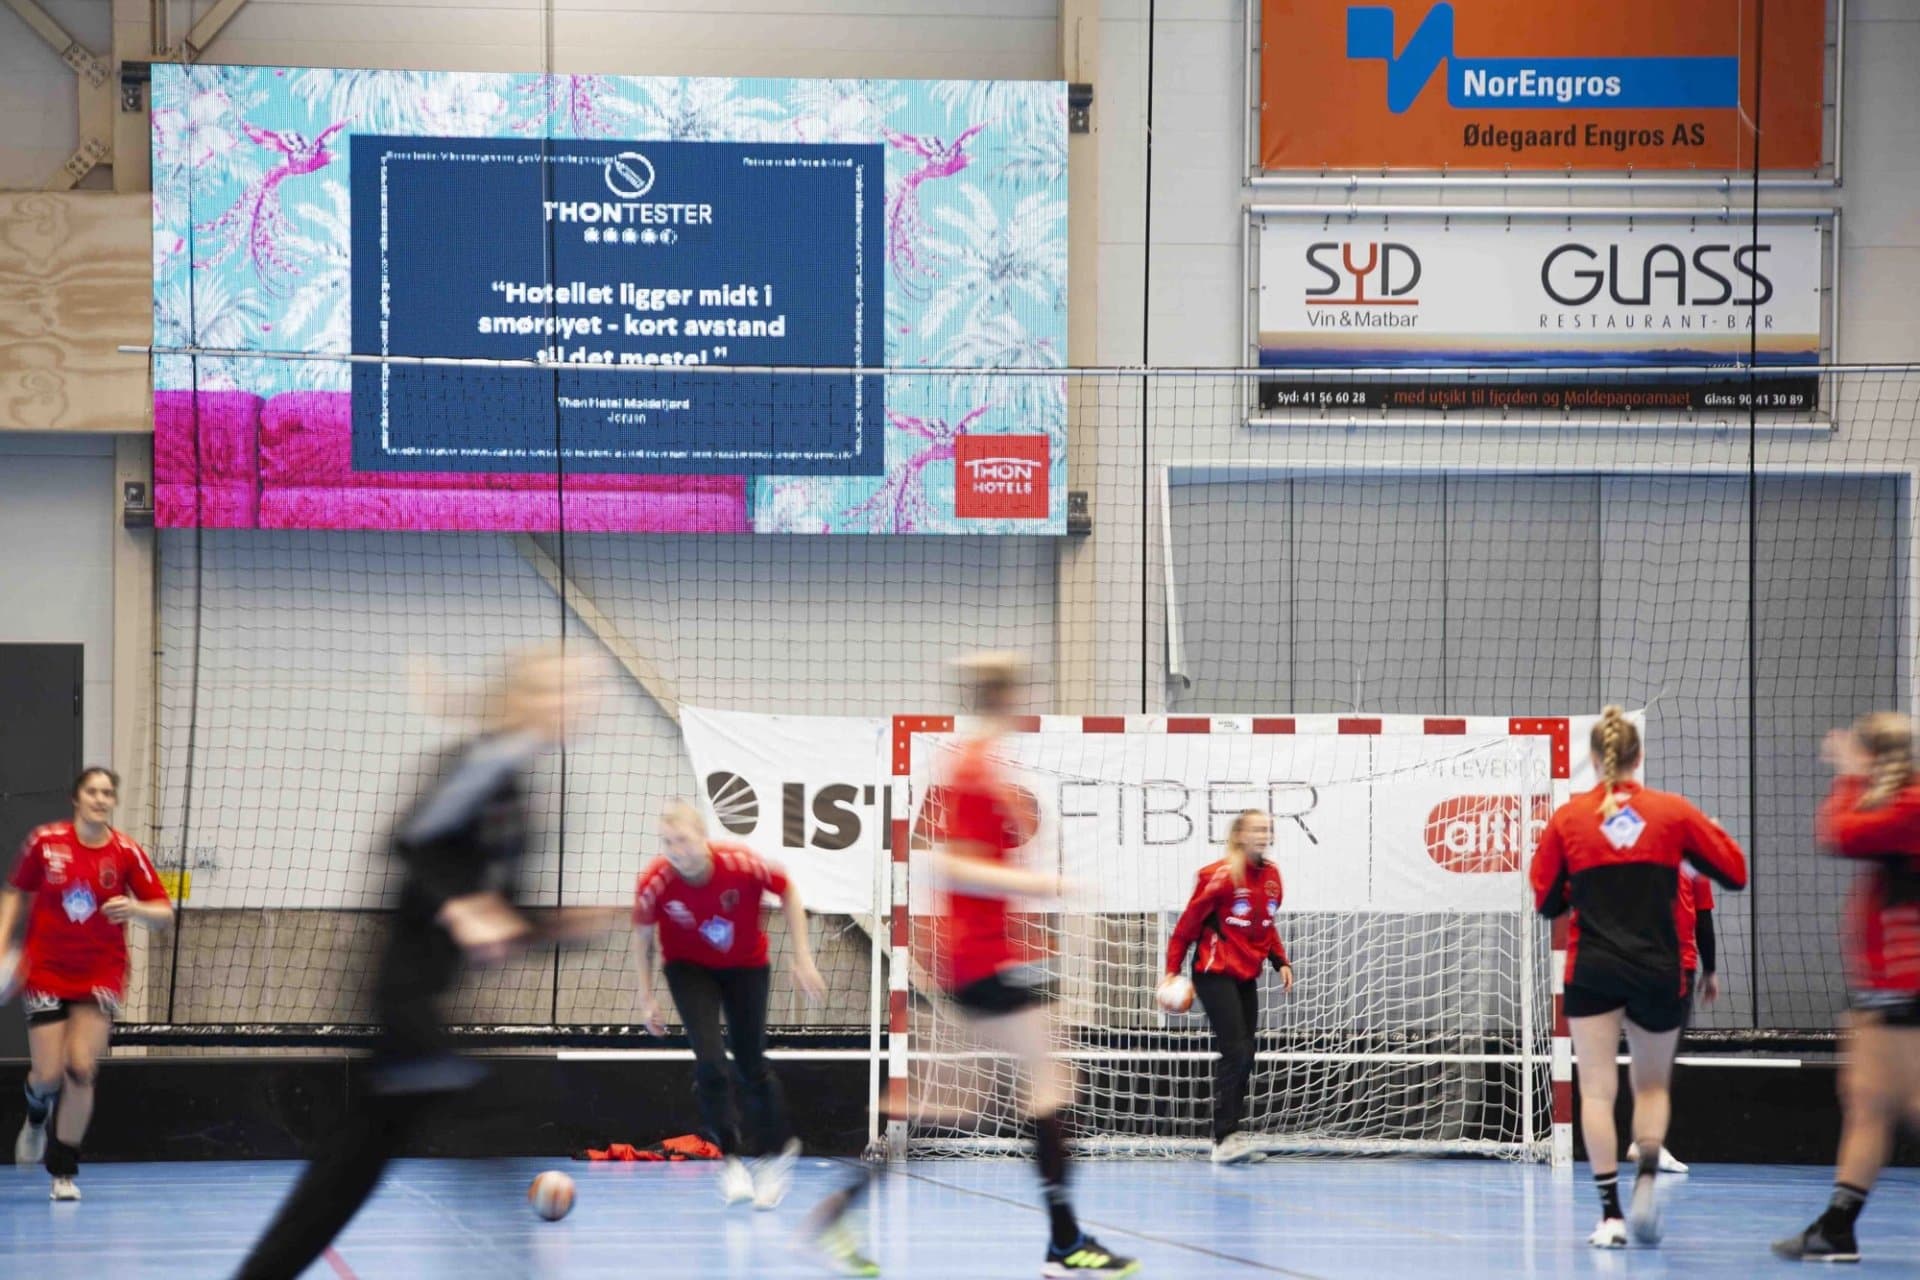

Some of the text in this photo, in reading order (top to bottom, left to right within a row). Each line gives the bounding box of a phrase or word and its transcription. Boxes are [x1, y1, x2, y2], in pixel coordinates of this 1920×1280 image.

[1464, 69, 1621, 103] NorEngros
[1464, 123, 1705, 151] Ødegaard Engros AS
[542, 202, 712, 224] THONTESTER
[1306, 242, 1421, 304] SYD
[1541, 243, 1773, 306] GLASS
[620, 283, 693, 311] ligger
[699, 285, 758, 306] midt
[764, 285, 772, 306] i
[624, 314, 678, 336] kort
[684, 315, 785, 337] avstand
[1307, 310, 1335, 327] Vin
[1355, 310, 1418, 327] Matbar
[569, 347, 614, 365] det
[1277, 391, 1366, 405] Syd: 41 56 60 28
[1394, 389, 1424, 404] med
[1429, 389, 1467, 404] utsikt
[1472, 389, 1484, 404] til
[1489, 388, 1537, 407] fjorden
[1543, 392, 1559, 407] og
[1704, 393, 1803, 405] Glass: 90 41 30 89
[965, 457, 1041, 480] THON
[973, 482, 1031, 495] HOTELS
[1059, 779, 1318, 846] FIBER
